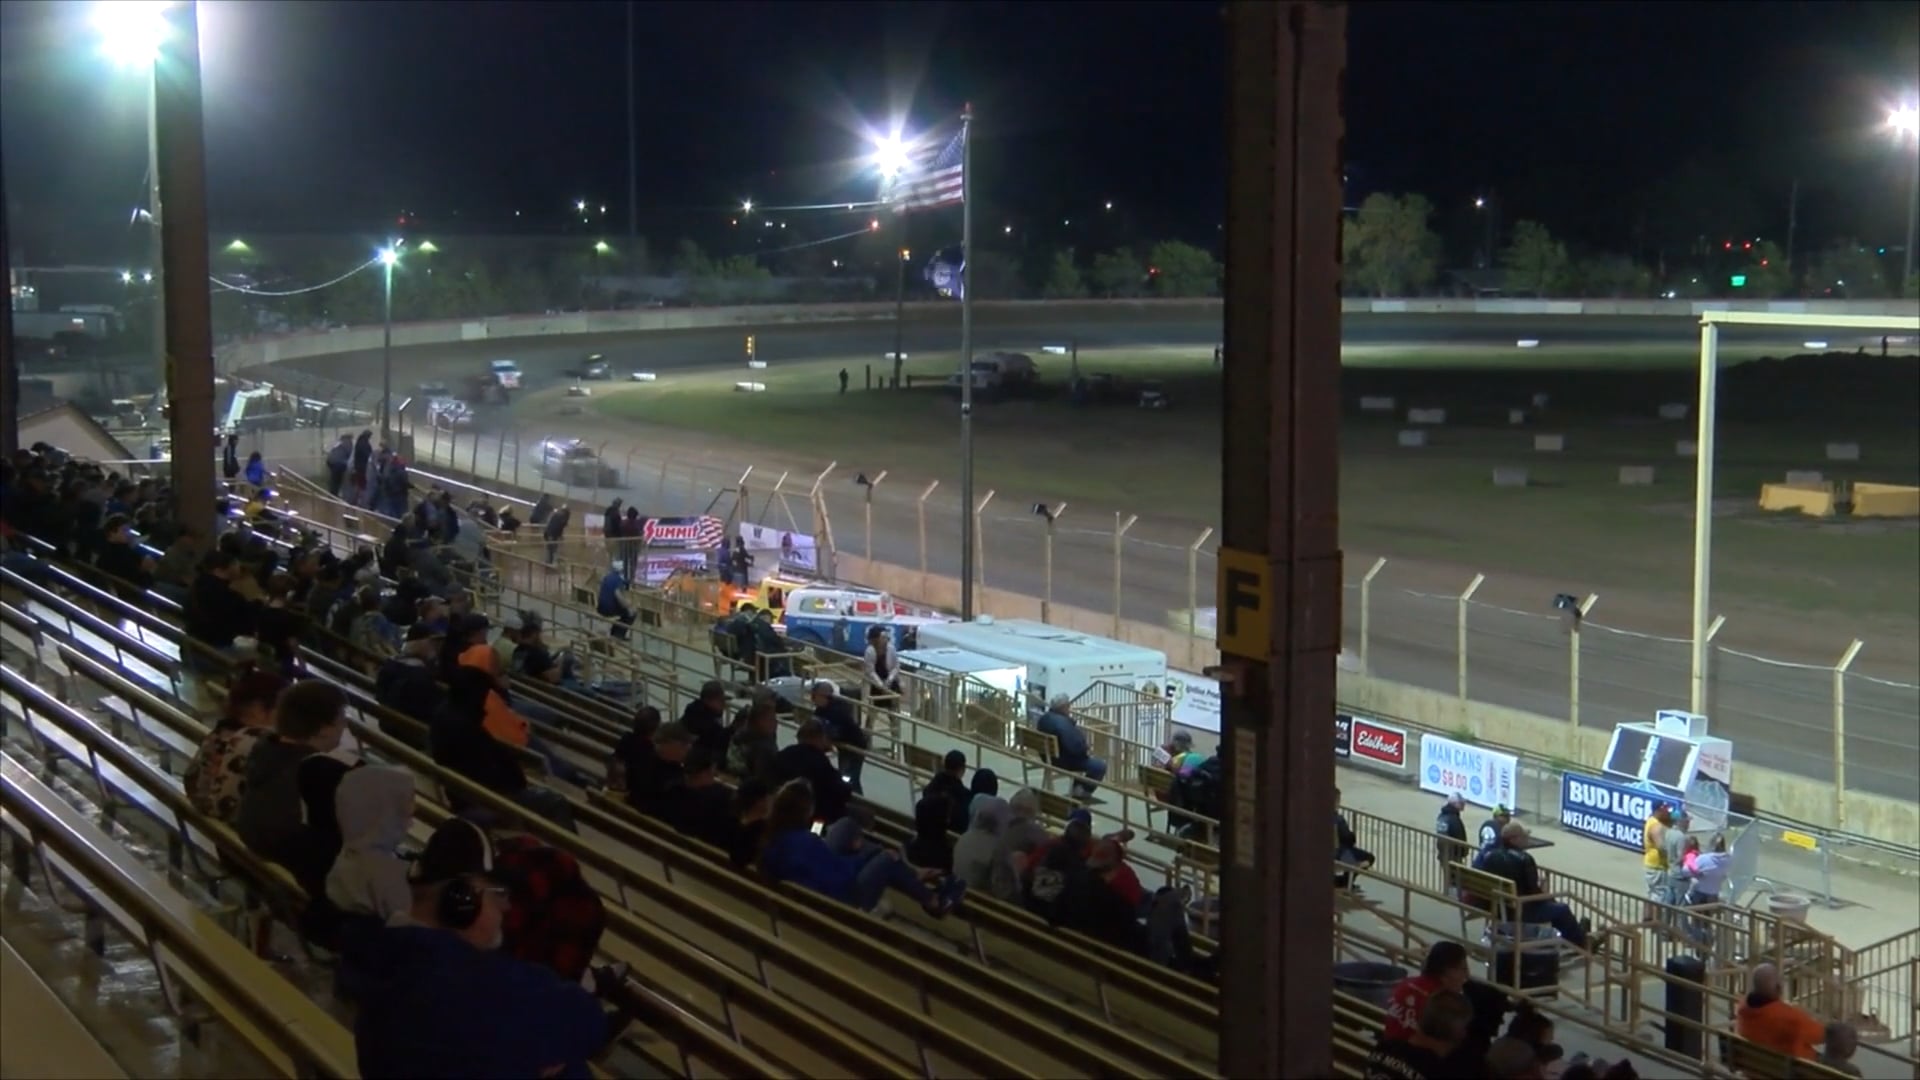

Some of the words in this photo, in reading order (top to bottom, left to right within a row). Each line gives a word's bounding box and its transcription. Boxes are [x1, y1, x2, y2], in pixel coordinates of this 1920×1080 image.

[1225, 567, 1261, 637] F
[1357, 730, 1399, 757] Edelbrock
[1428, 741, 1451, 764] MAN
[1454, 748, 1482, 772] CANS
[1569, 780, 1611, 810] BUD
[1563, 809, 1615, 838] WELCOME
[1616, 823, 1643, 846] RACE
